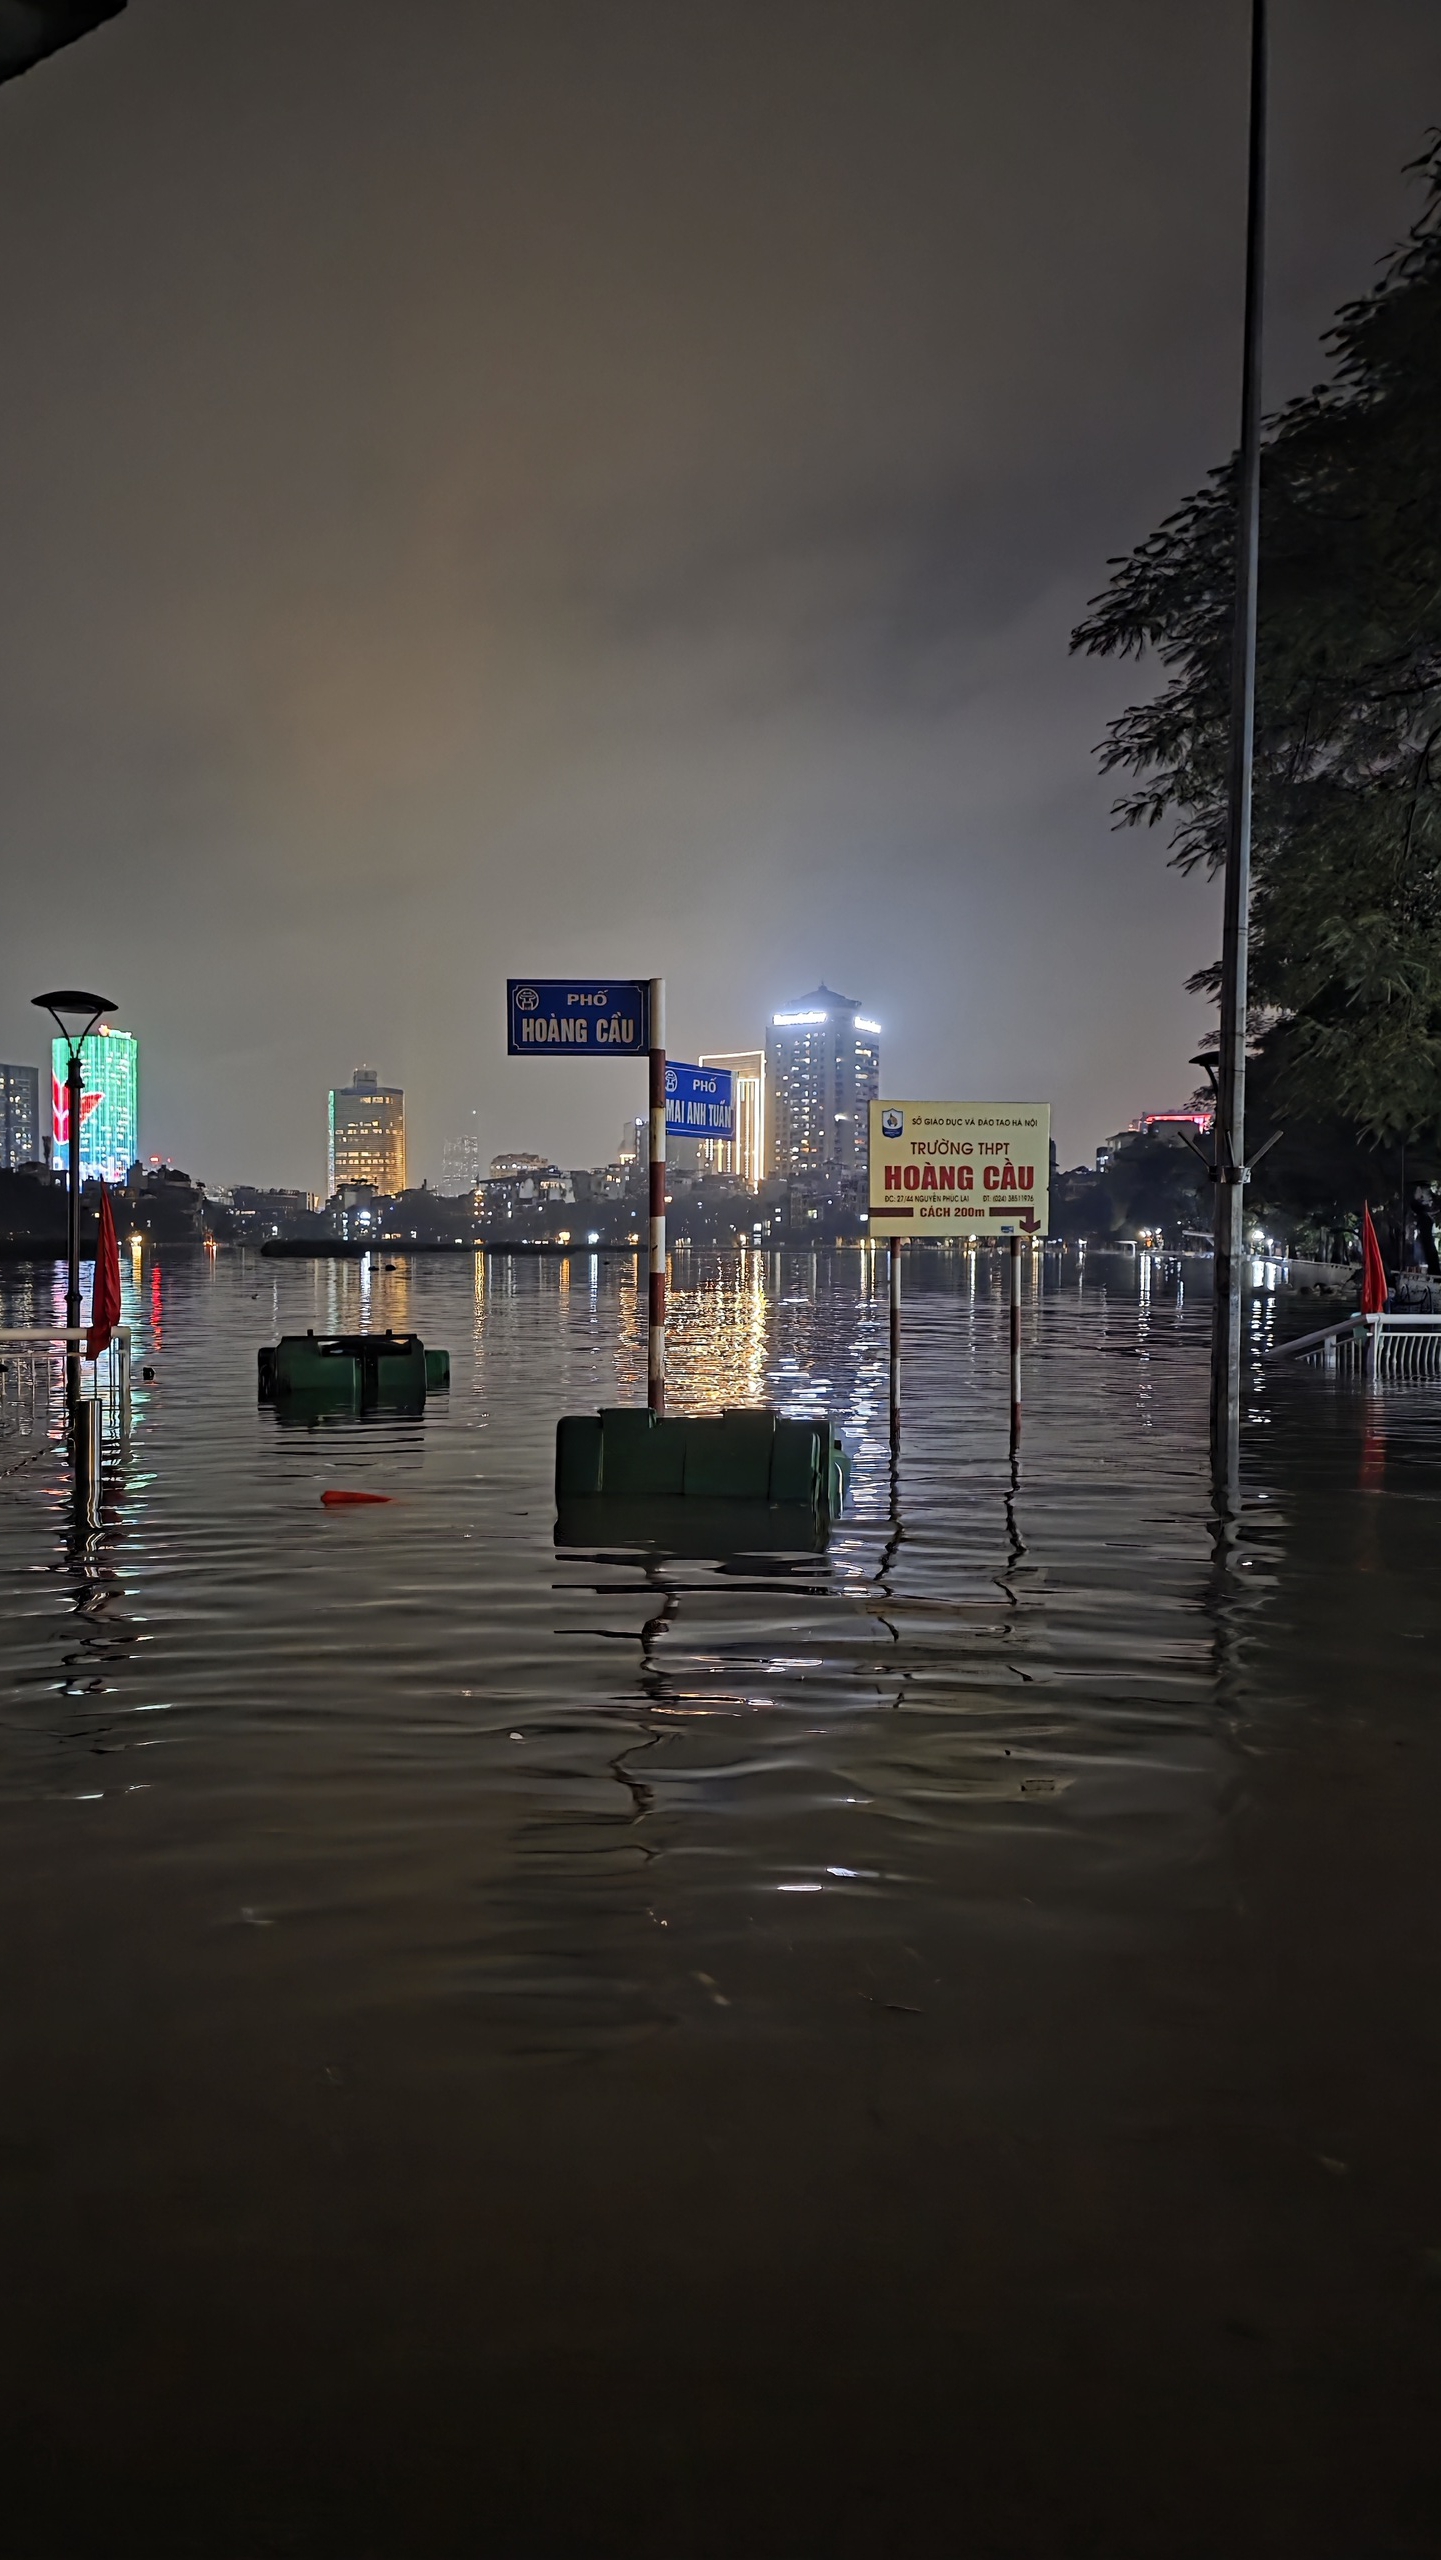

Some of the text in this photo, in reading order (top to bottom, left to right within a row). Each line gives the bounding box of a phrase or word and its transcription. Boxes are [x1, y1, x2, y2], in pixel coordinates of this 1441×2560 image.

[567, 989, 609, 1006] PHỐ
[522, 1011, 634, 1043] HOÀNG CẦU
[693, 1077, 717, 1093] PHỐ
[665, 1098, 731, 1128] MAI ANH TUẤN
[910, 1138, 1010, 1155] TRƯỜNG THPT
[884, 1158, 1034, 1191] HOÀNG CẦU
[920, 1205, 985, 1218] CÁCH 200m
